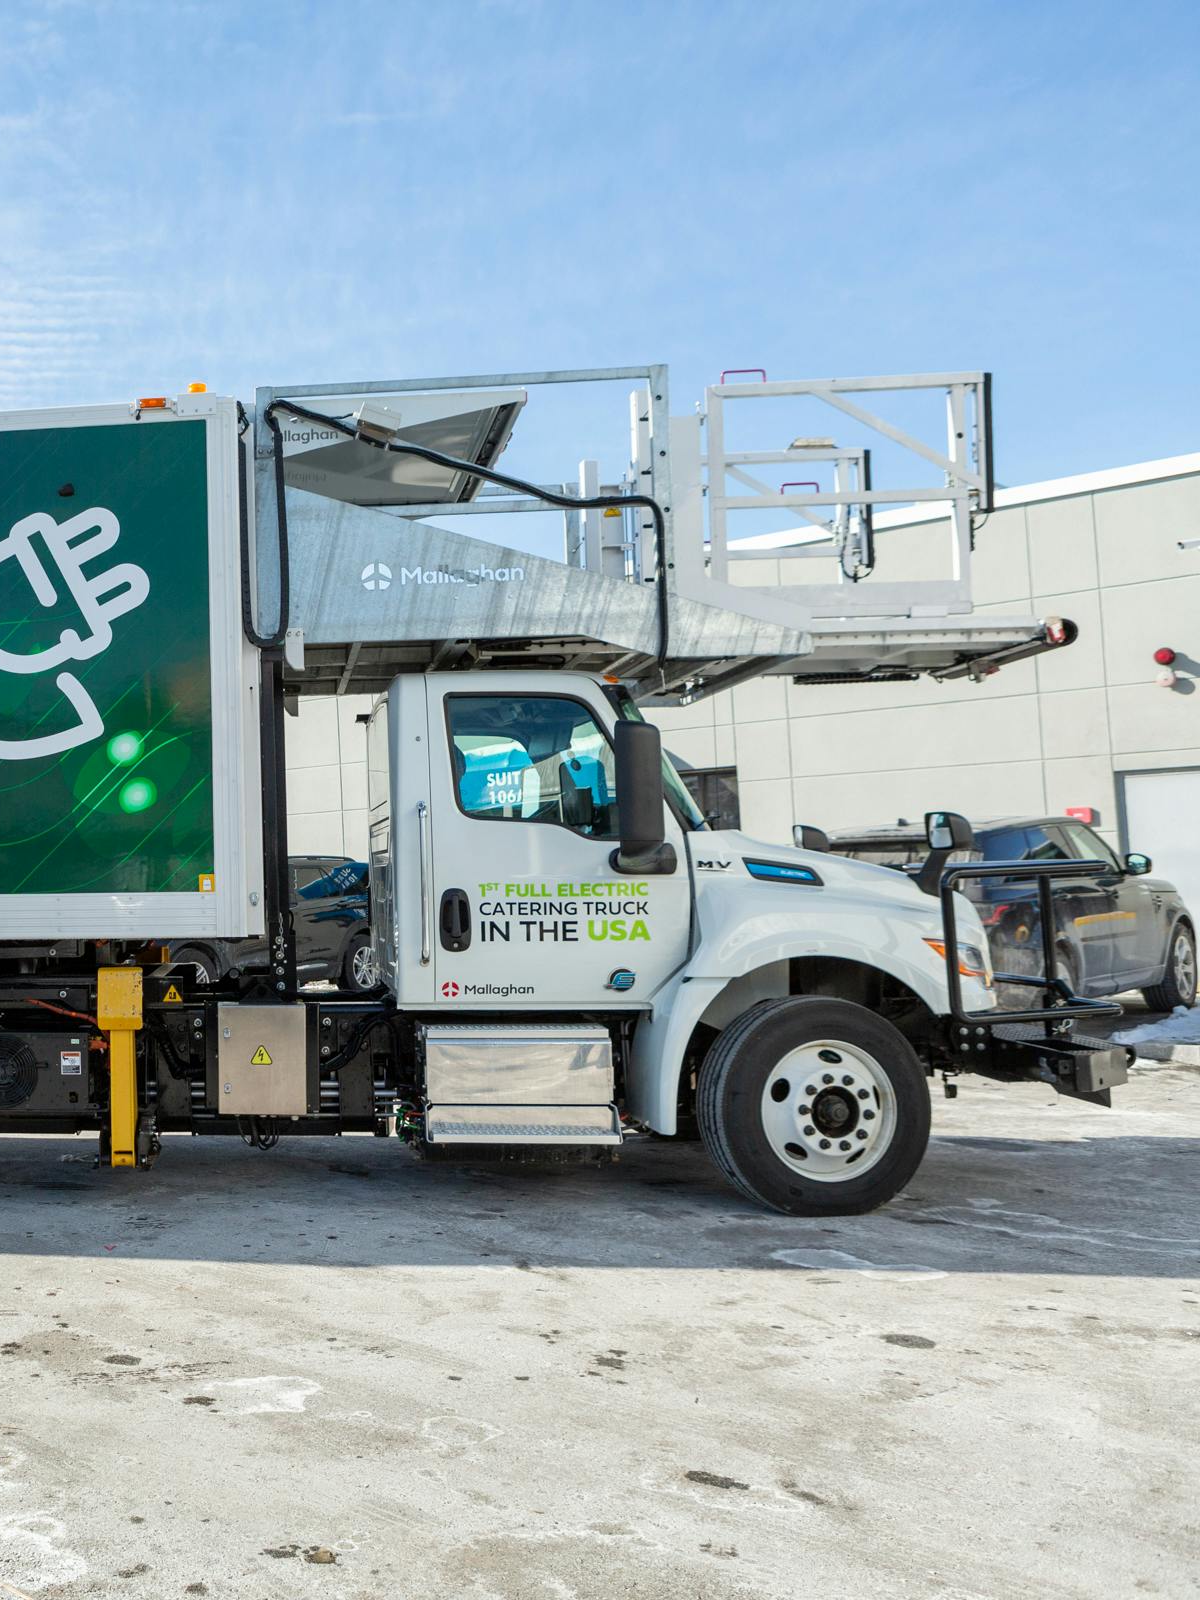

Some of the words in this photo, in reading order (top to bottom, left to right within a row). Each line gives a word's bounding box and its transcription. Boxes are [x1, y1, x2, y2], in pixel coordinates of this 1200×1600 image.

[282, 427, 339, 444] llaghan
[401, 564, 524, 587] Mallaghan
[486, 771, 521, 787] SUIT
[696, 860, 732, 869] MV
[505, 883, 552, 897] FULL
[557, 882, 649, 897] ELECTRIC
[479, 902, 577, 915] CATERING
[583, 901, 649, 915] TRUCK
[480, 920, 510, 942] IN
[519, 920, 579, 942] THE
[587, 919, 651, 942] USA
[464, 983, 535, 997] Mallaghan
